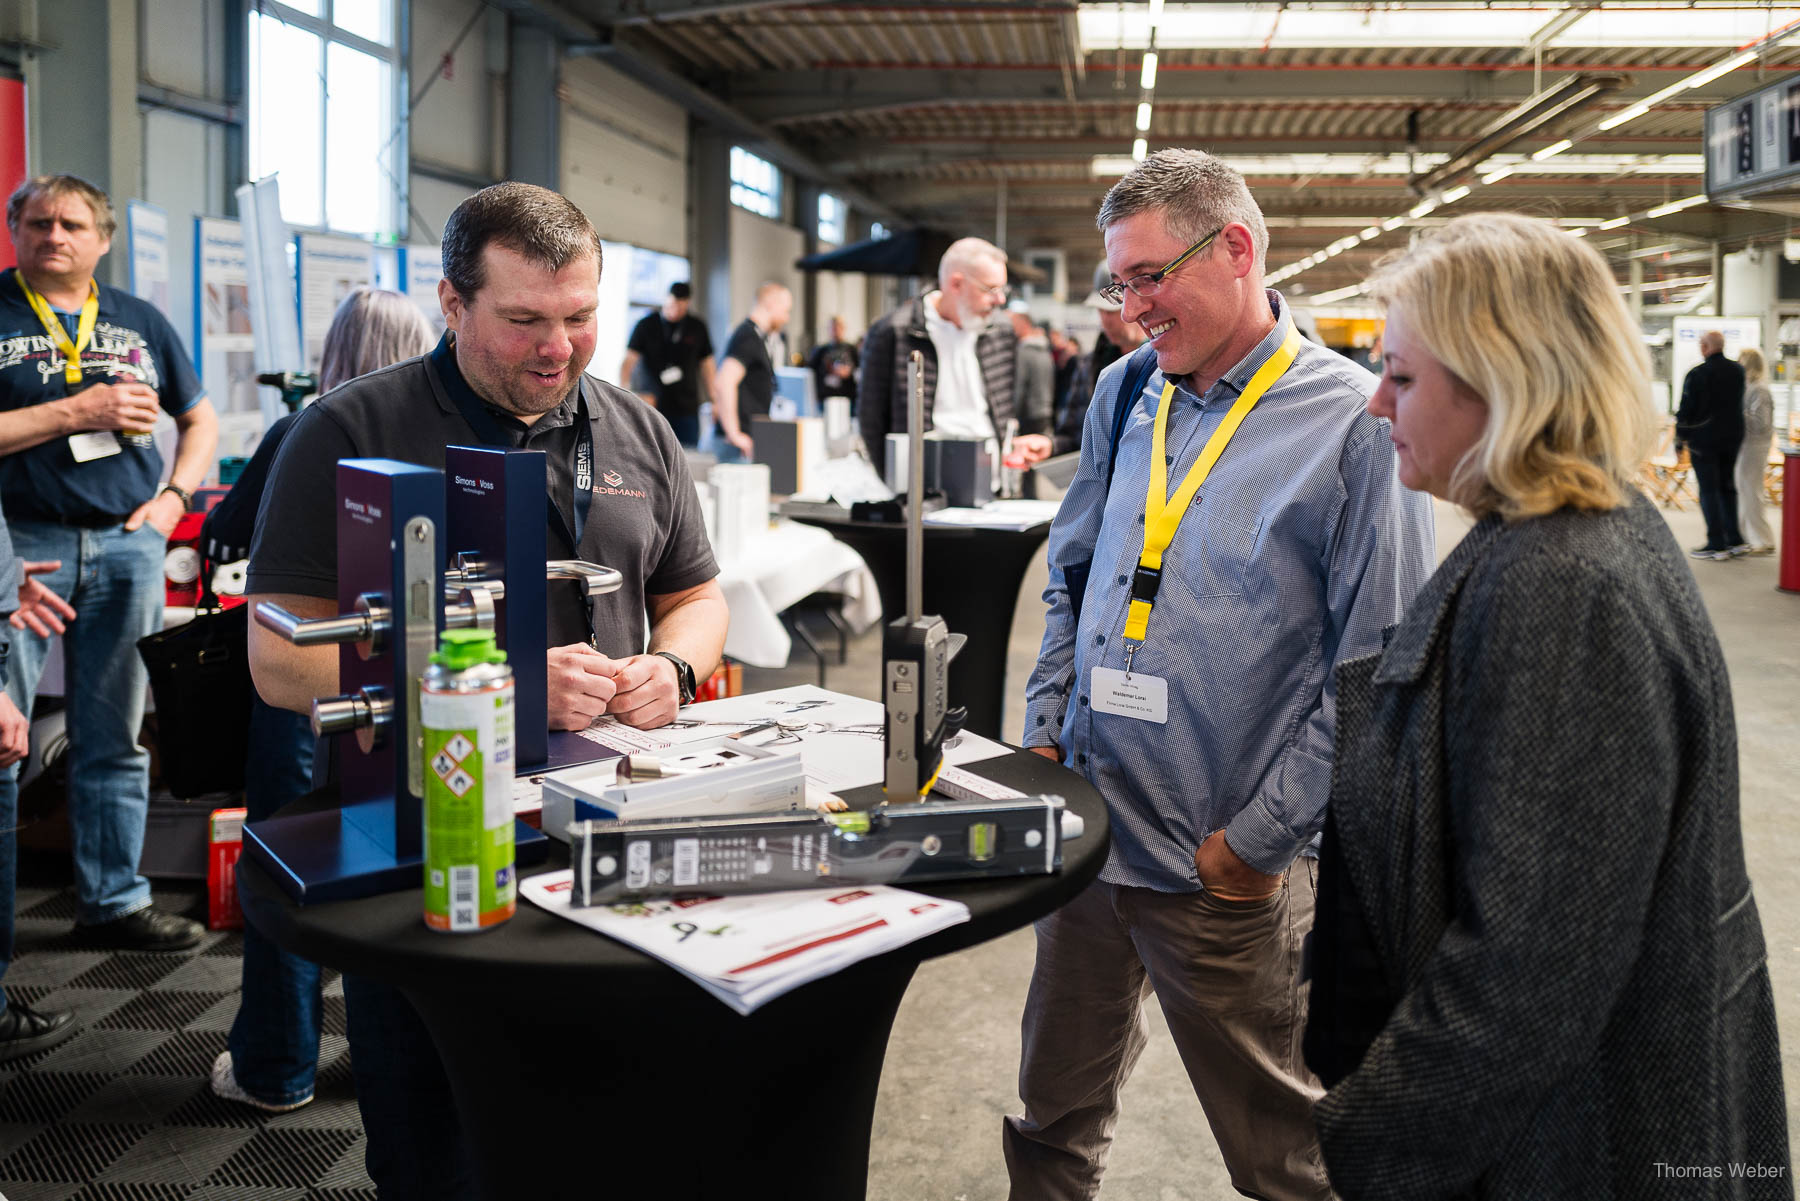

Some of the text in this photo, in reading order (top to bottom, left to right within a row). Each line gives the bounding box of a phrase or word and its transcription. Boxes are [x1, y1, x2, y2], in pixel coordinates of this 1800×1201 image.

[455, 475, 494, 490] Simons Voss
[576, 442, 591, 491] SIEMS
